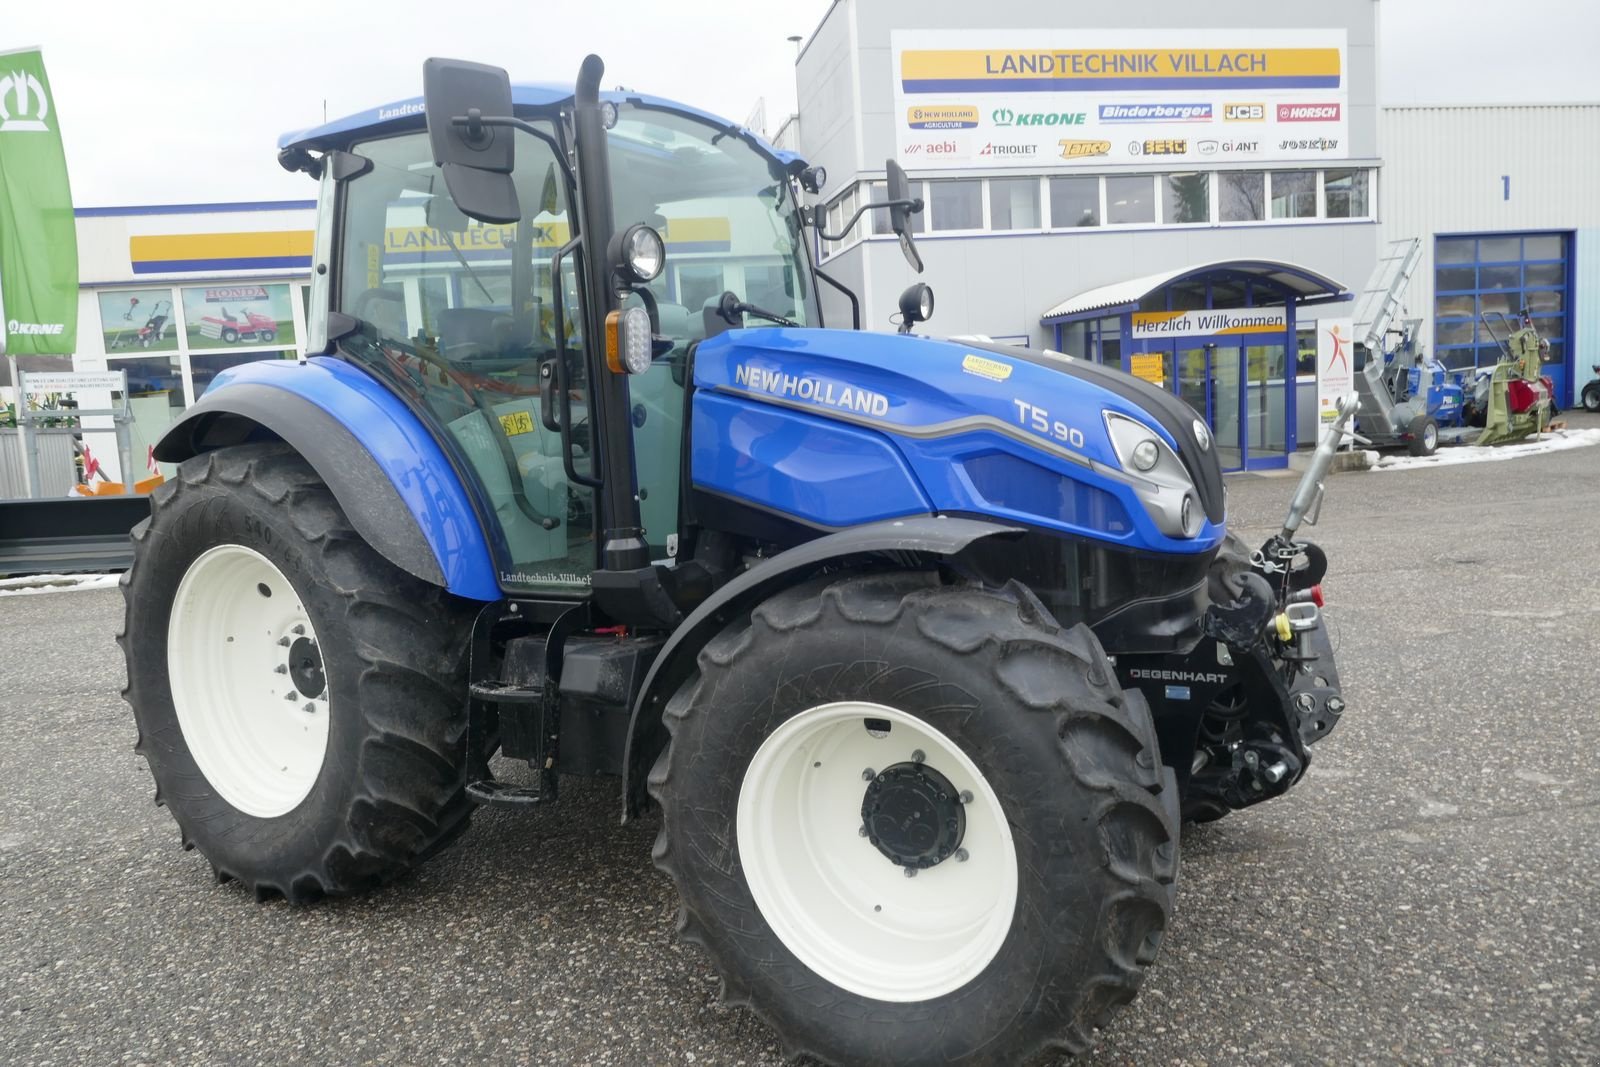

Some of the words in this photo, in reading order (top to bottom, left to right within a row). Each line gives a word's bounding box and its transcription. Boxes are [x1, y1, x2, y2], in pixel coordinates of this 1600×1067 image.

[985, 53, 1158, 74] LANDTECHNIK
[1169, 53, 1267, 72] VILLACH
[924, 110, 941, 118] NEW
[941, 110, 973, 118] HOLLAND
[1016, 112, 1087, 126] KRONE
[1102, 105, 1210, 119] Binderberger
[1226, 105, 1264, 119] JCB
[1290, 106, 1337, 119] HORSCH
[926, 140, 957, 154] aebi
[1058, 139, 1112, 159] Tanco
[1501, 175, 1510, 201] 1
[206, 287, 268, 298] HONDA
[1136, 316, 1192, 333] Herzlich
[1197, 314, 1284, 330] Willkommen
[735, 364, 780, 393] NEW
[782, 374, 889, 417] HOLLAND
[1014, 398, 1084, 449] T5.90
[1130, 669, 1228, 683] DEGENHART
